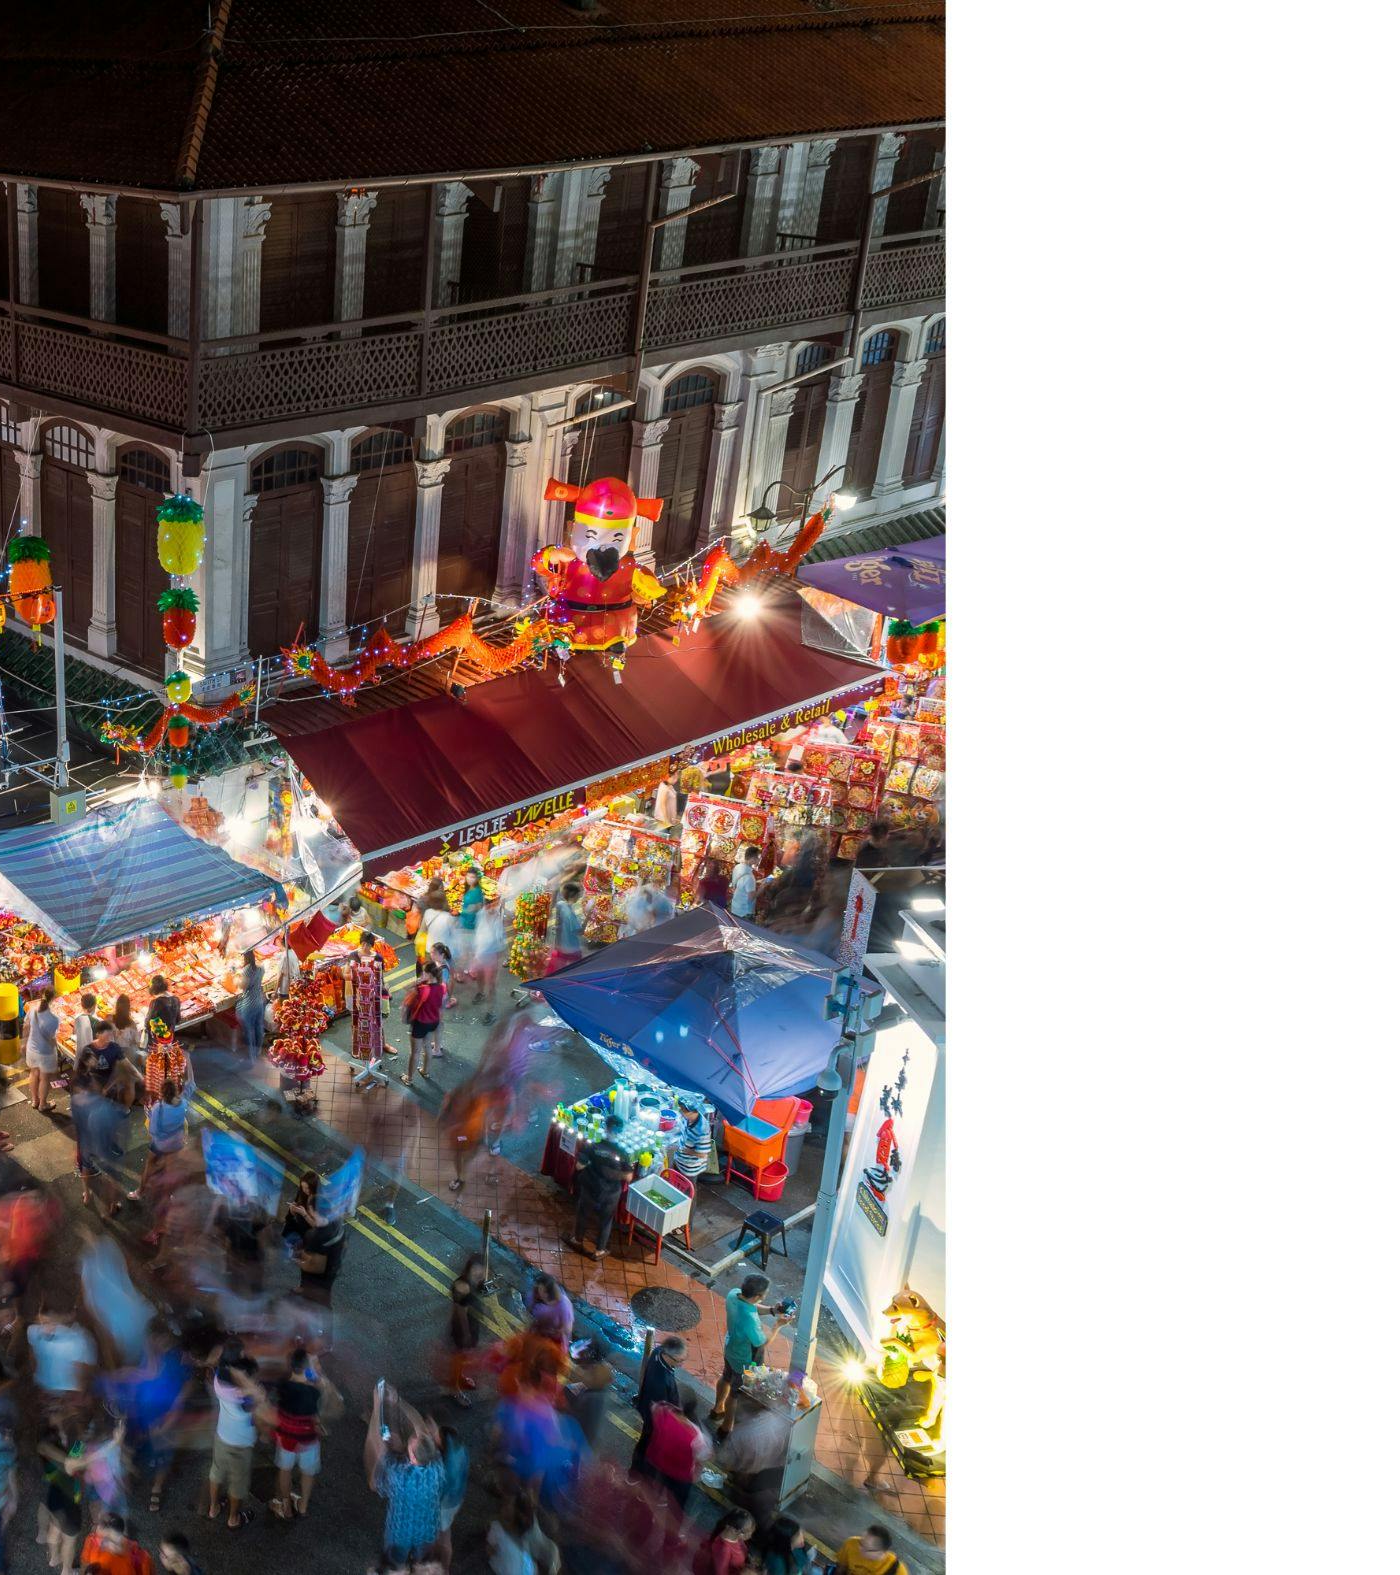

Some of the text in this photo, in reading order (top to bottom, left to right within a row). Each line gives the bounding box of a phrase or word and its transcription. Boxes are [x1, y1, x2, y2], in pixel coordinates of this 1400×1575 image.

[713, 698, 831, 755] Wholesale & Retail
[458, 791, 575, 846] LESLIE JAVELLE
